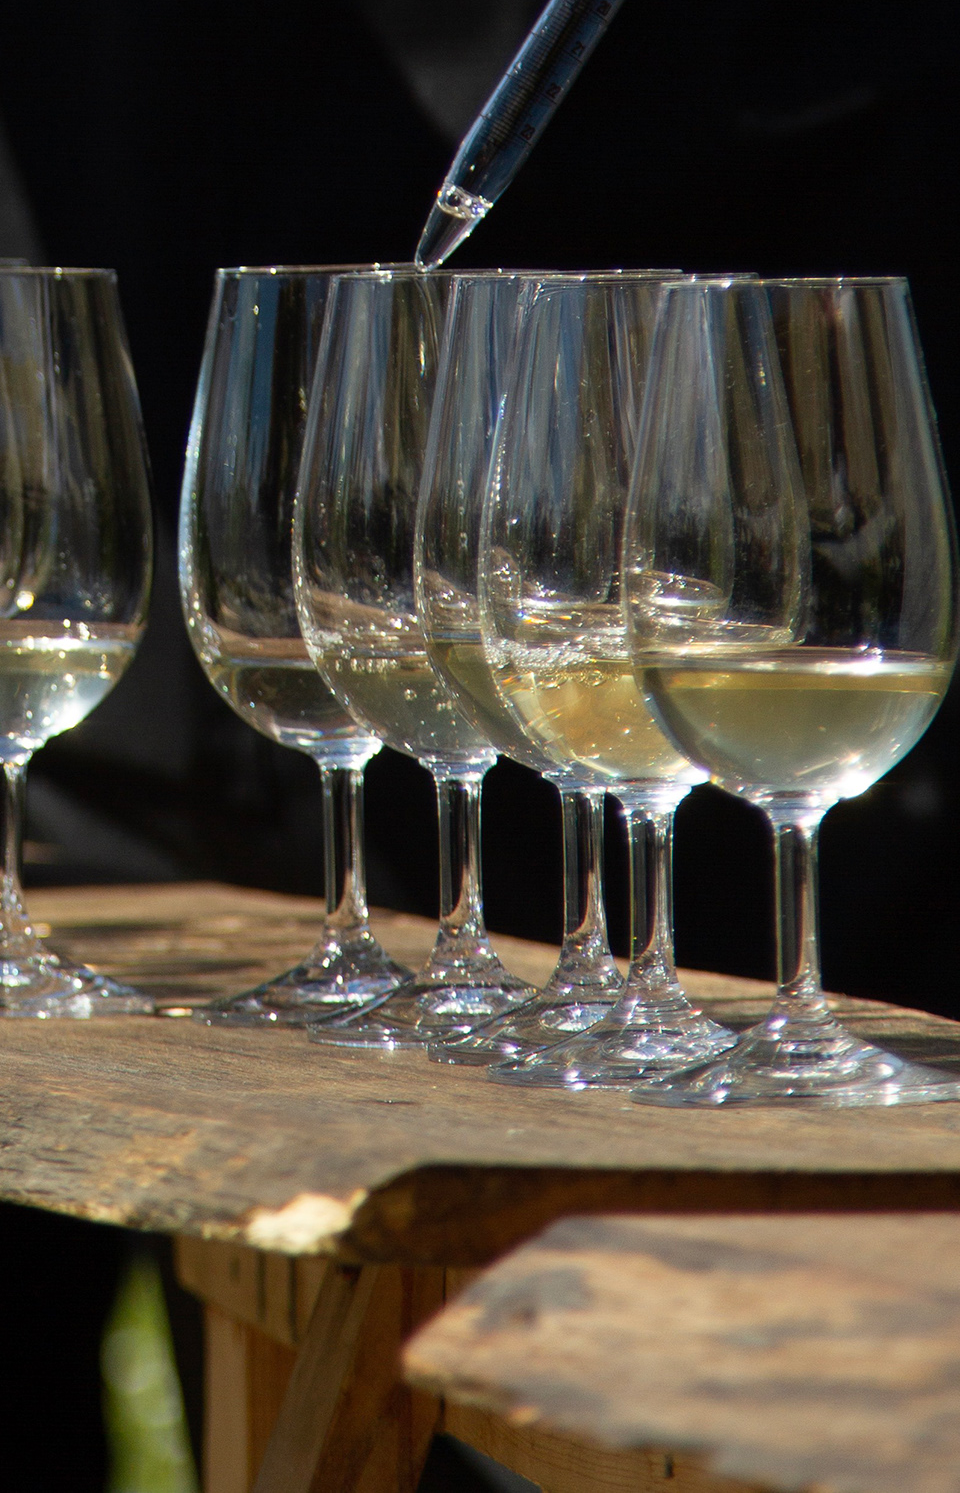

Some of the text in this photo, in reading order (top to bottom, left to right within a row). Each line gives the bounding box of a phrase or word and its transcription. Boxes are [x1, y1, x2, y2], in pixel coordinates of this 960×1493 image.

[597, 0, 611, 16] 20
[571, 40, 584, 58] 21
[545, 82, 561, 98] 22
[520, 123, 535, 140] 23
